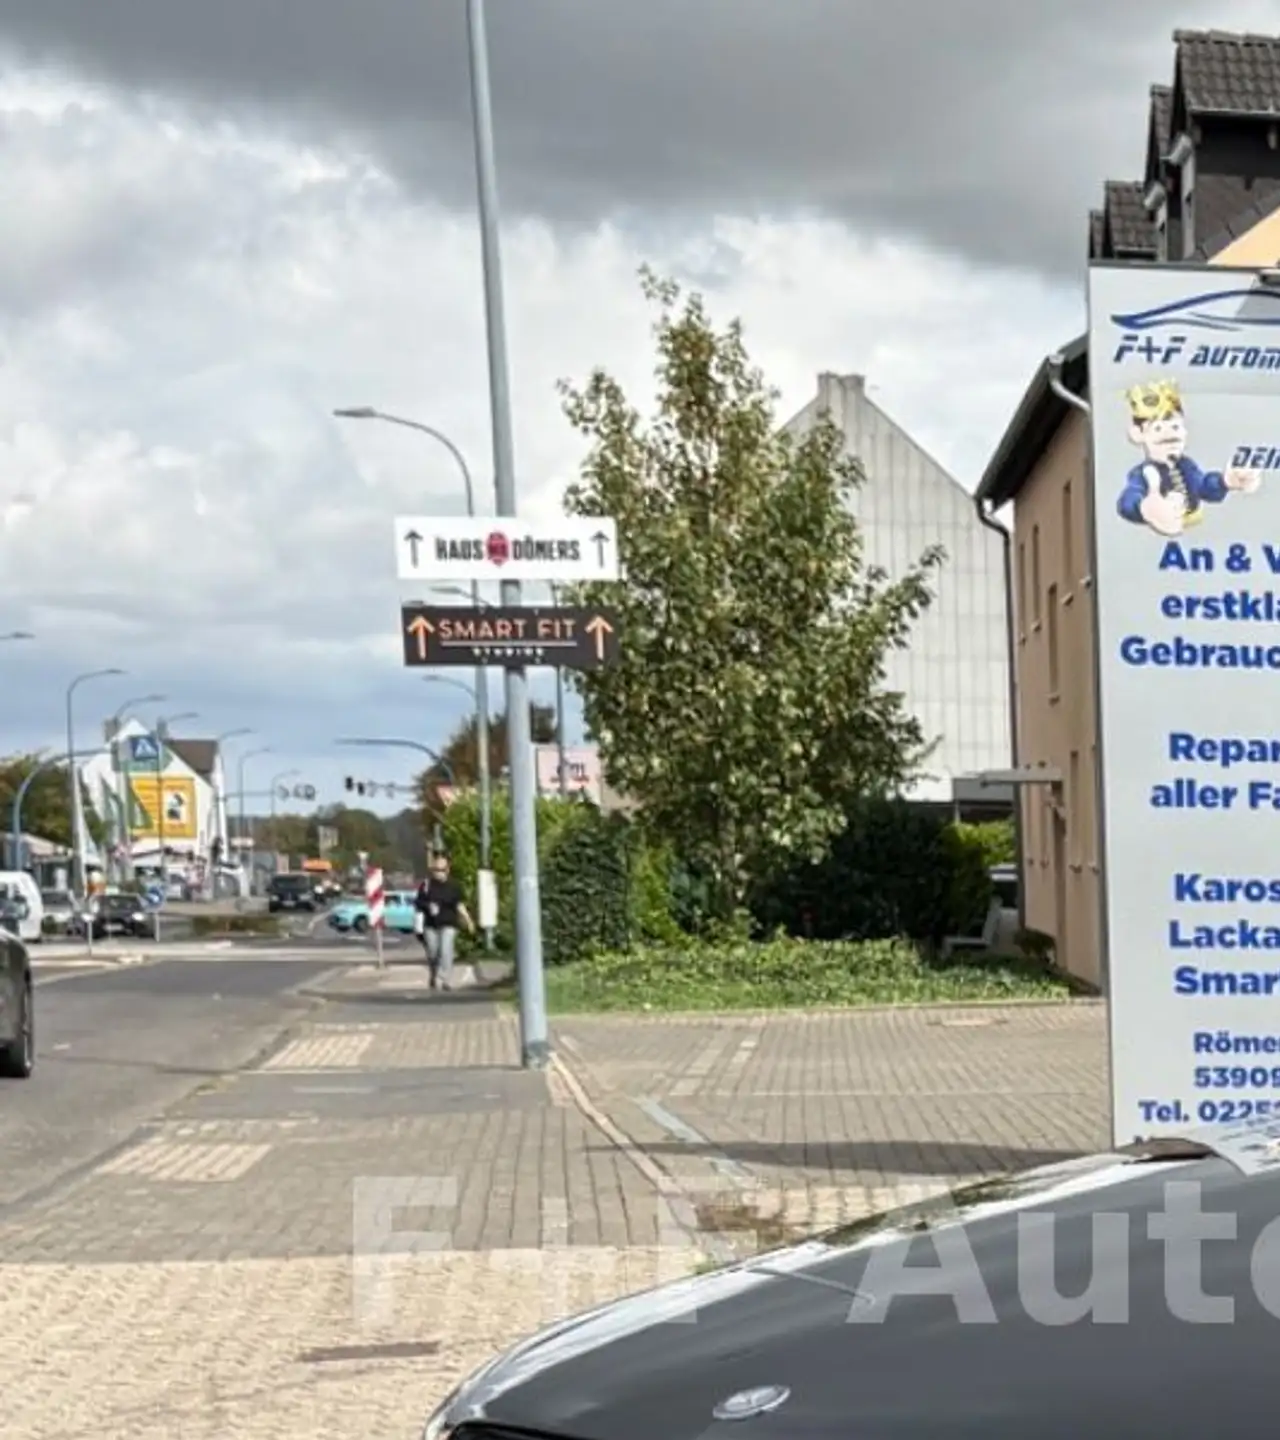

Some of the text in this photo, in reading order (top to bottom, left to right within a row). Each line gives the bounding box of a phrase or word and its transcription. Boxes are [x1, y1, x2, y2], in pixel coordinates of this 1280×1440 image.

[1113, 334, 1186, 364] F+F
[435, 537, 483, 561] HAUS
[1160, 541, 1215, 572] An
[1225, 544, 1252, 572] &
[438, 618, 577, 640] SMART FIT
[1150, 778, 1238, 809] aller
[1139, 1101, 1189, 1122] Tel.
